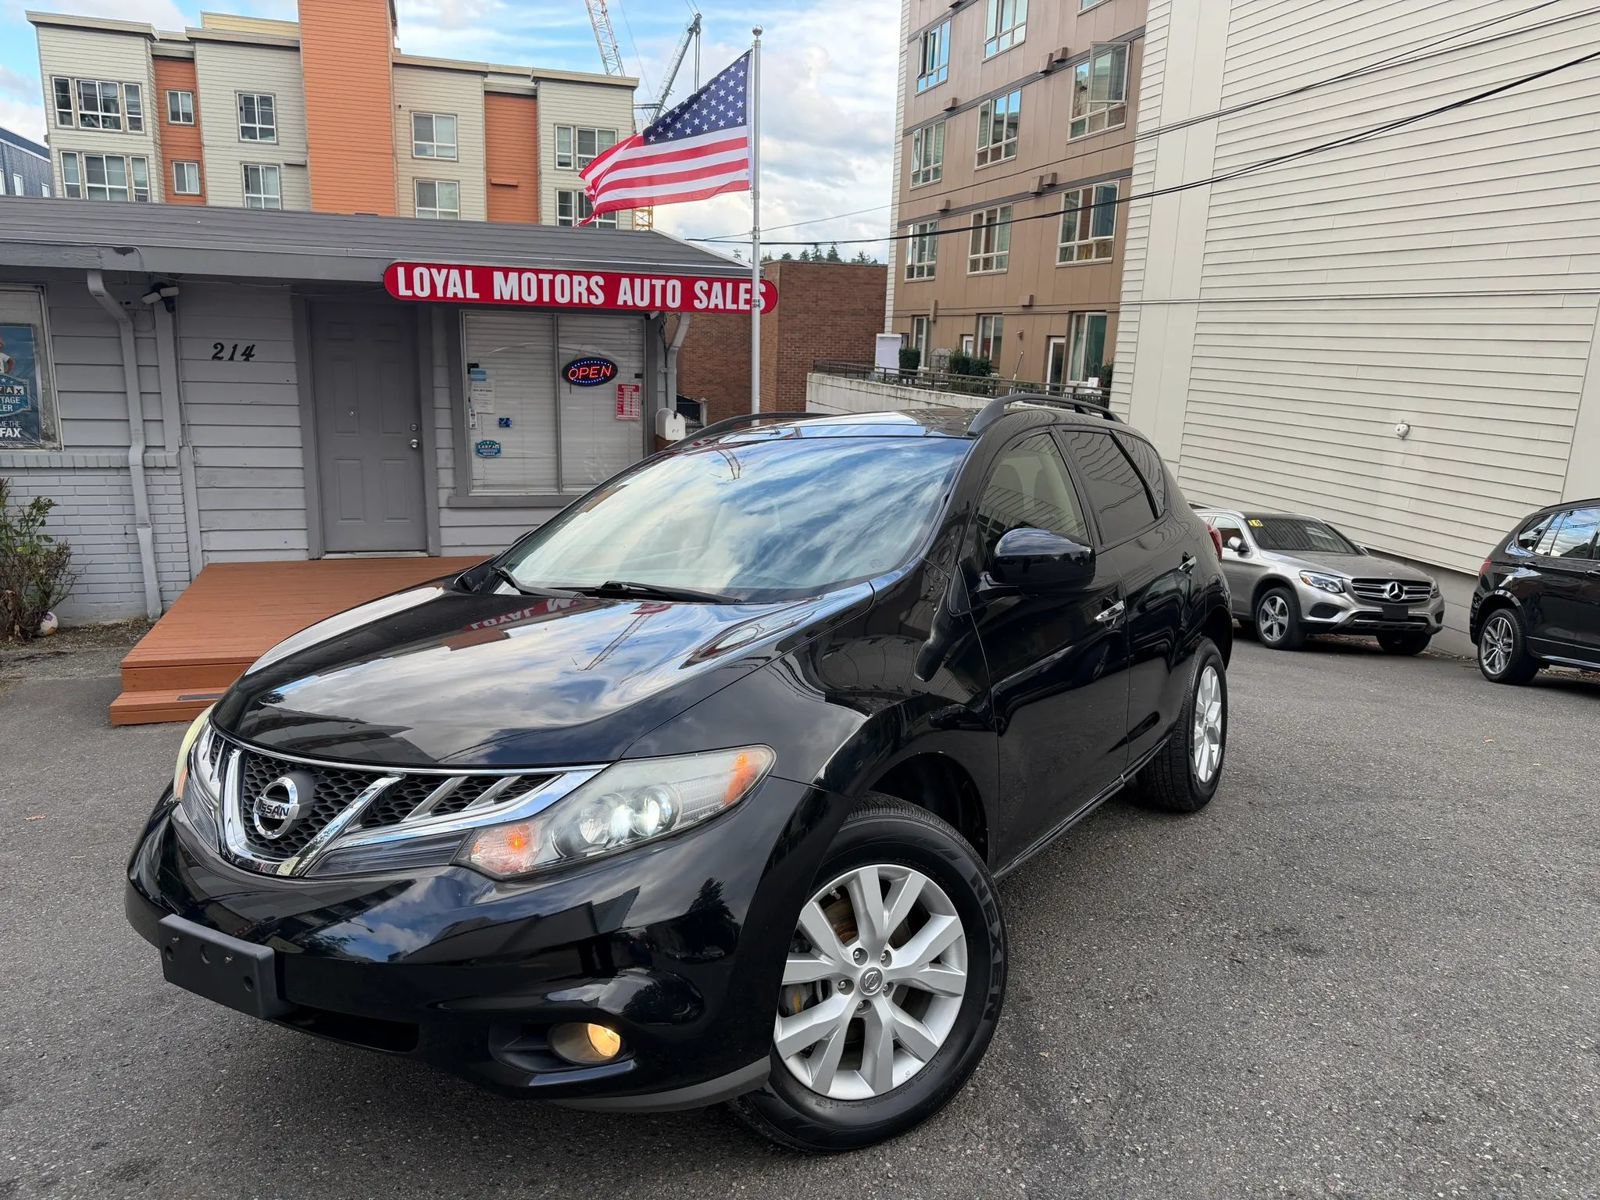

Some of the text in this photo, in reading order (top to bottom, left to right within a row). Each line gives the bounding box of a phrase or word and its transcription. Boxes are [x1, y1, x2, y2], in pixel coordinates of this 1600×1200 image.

[397, 266, 480, 299] LOYAL
[493, 271, 605, 305] MOTORS
[617, 277, 682, 309] AUTO
[211, 342, 256, 362] 214
[568, 364, 613, 380] OPEN
[969, 870, 1003, 1021] NEXEN
